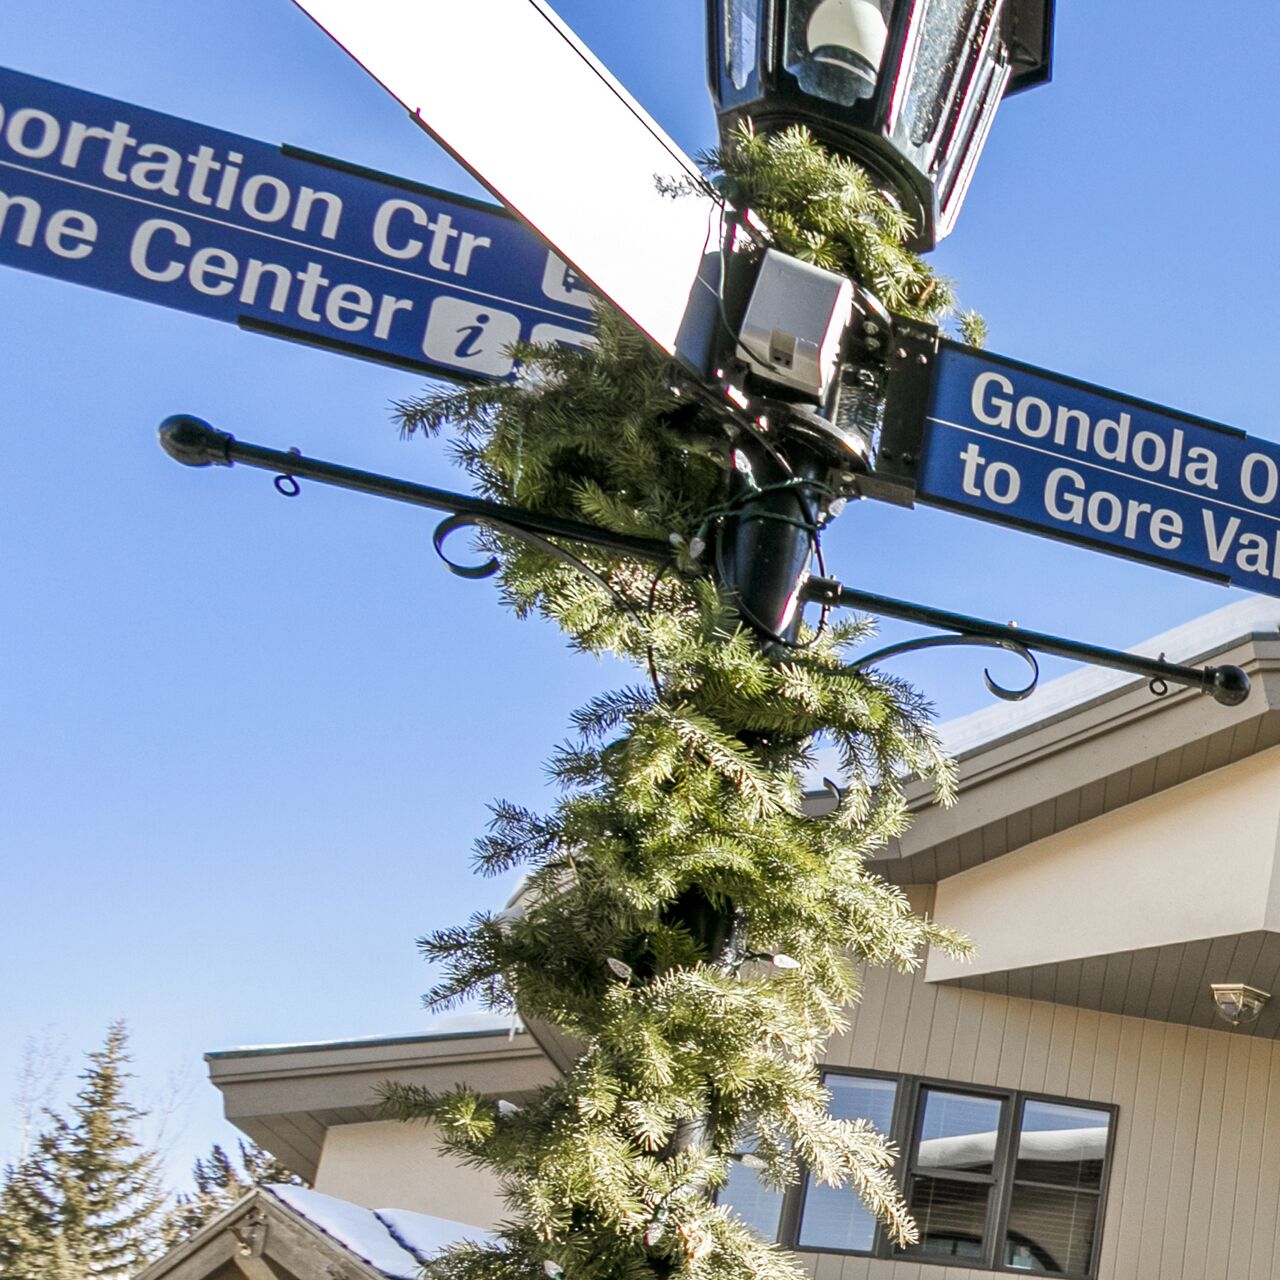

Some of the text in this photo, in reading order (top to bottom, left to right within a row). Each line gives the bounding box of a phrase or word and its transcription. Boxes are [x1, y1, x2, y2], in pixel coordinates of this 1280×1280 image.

[0, 103, 491, 276] ortation Ctr
[130, 219, 413, 340] Center
[971, 371, 1219, 490] Gondola
[960, 443, 1021, 504] to
[1044, 467, 1184, 550] Gore
